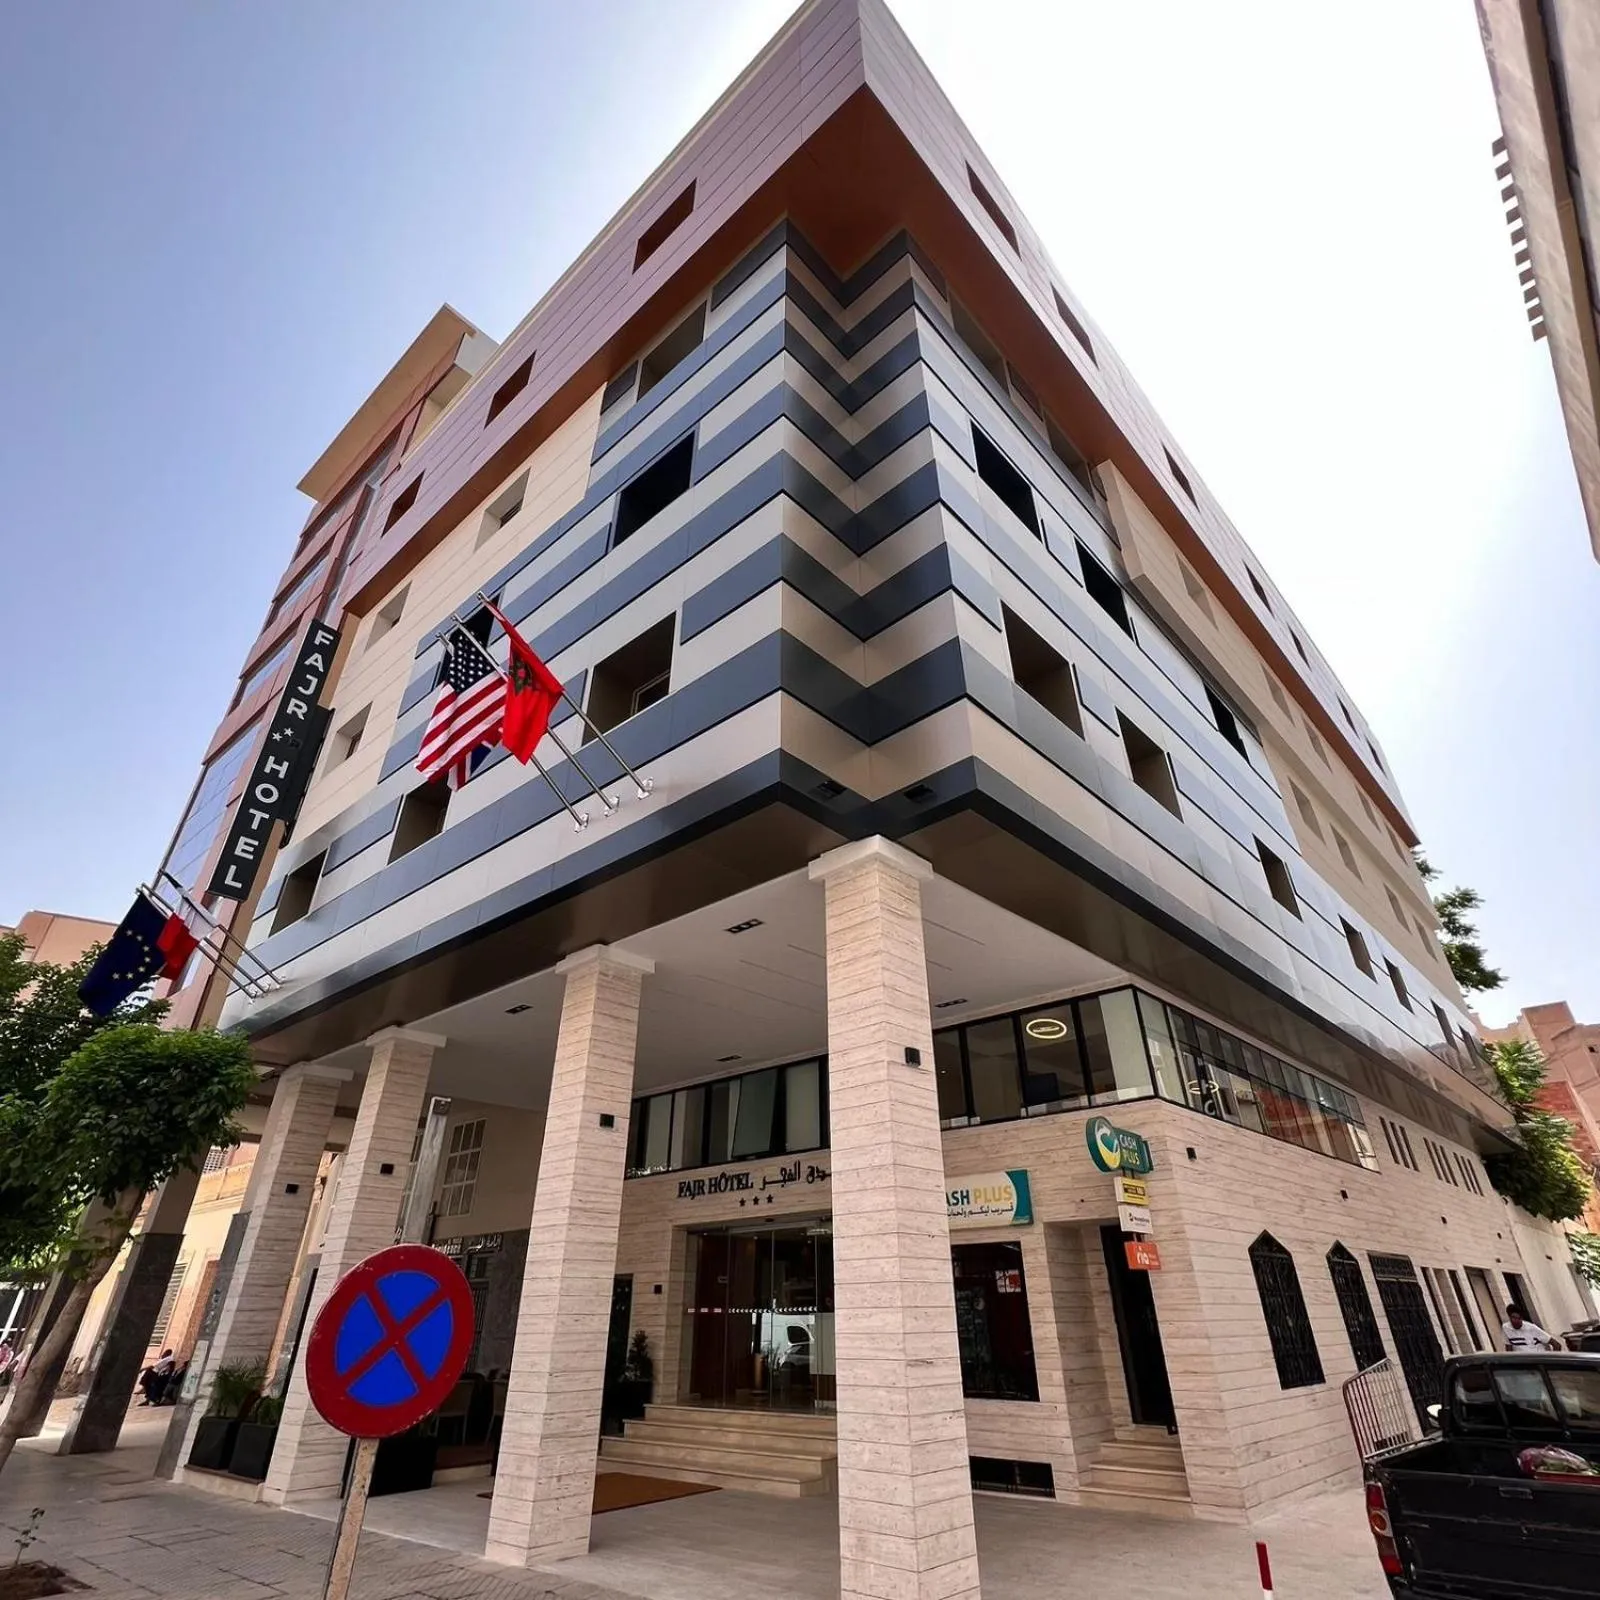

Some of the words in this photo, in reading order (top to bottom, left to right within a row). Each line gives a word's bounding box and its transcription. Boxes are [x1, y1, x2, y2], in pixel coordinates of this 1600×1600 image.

[286, 629, 334, 721] FAJR
[224, 755, 290, 889] HOTEL
[1119, 1134, 1138, 1150] CASH
[677, 1178, 706, 1200] FAJR
[708, 1171, 754, 1195] HÔTEL
[973, 1184, 1013, 1204] PLUS
